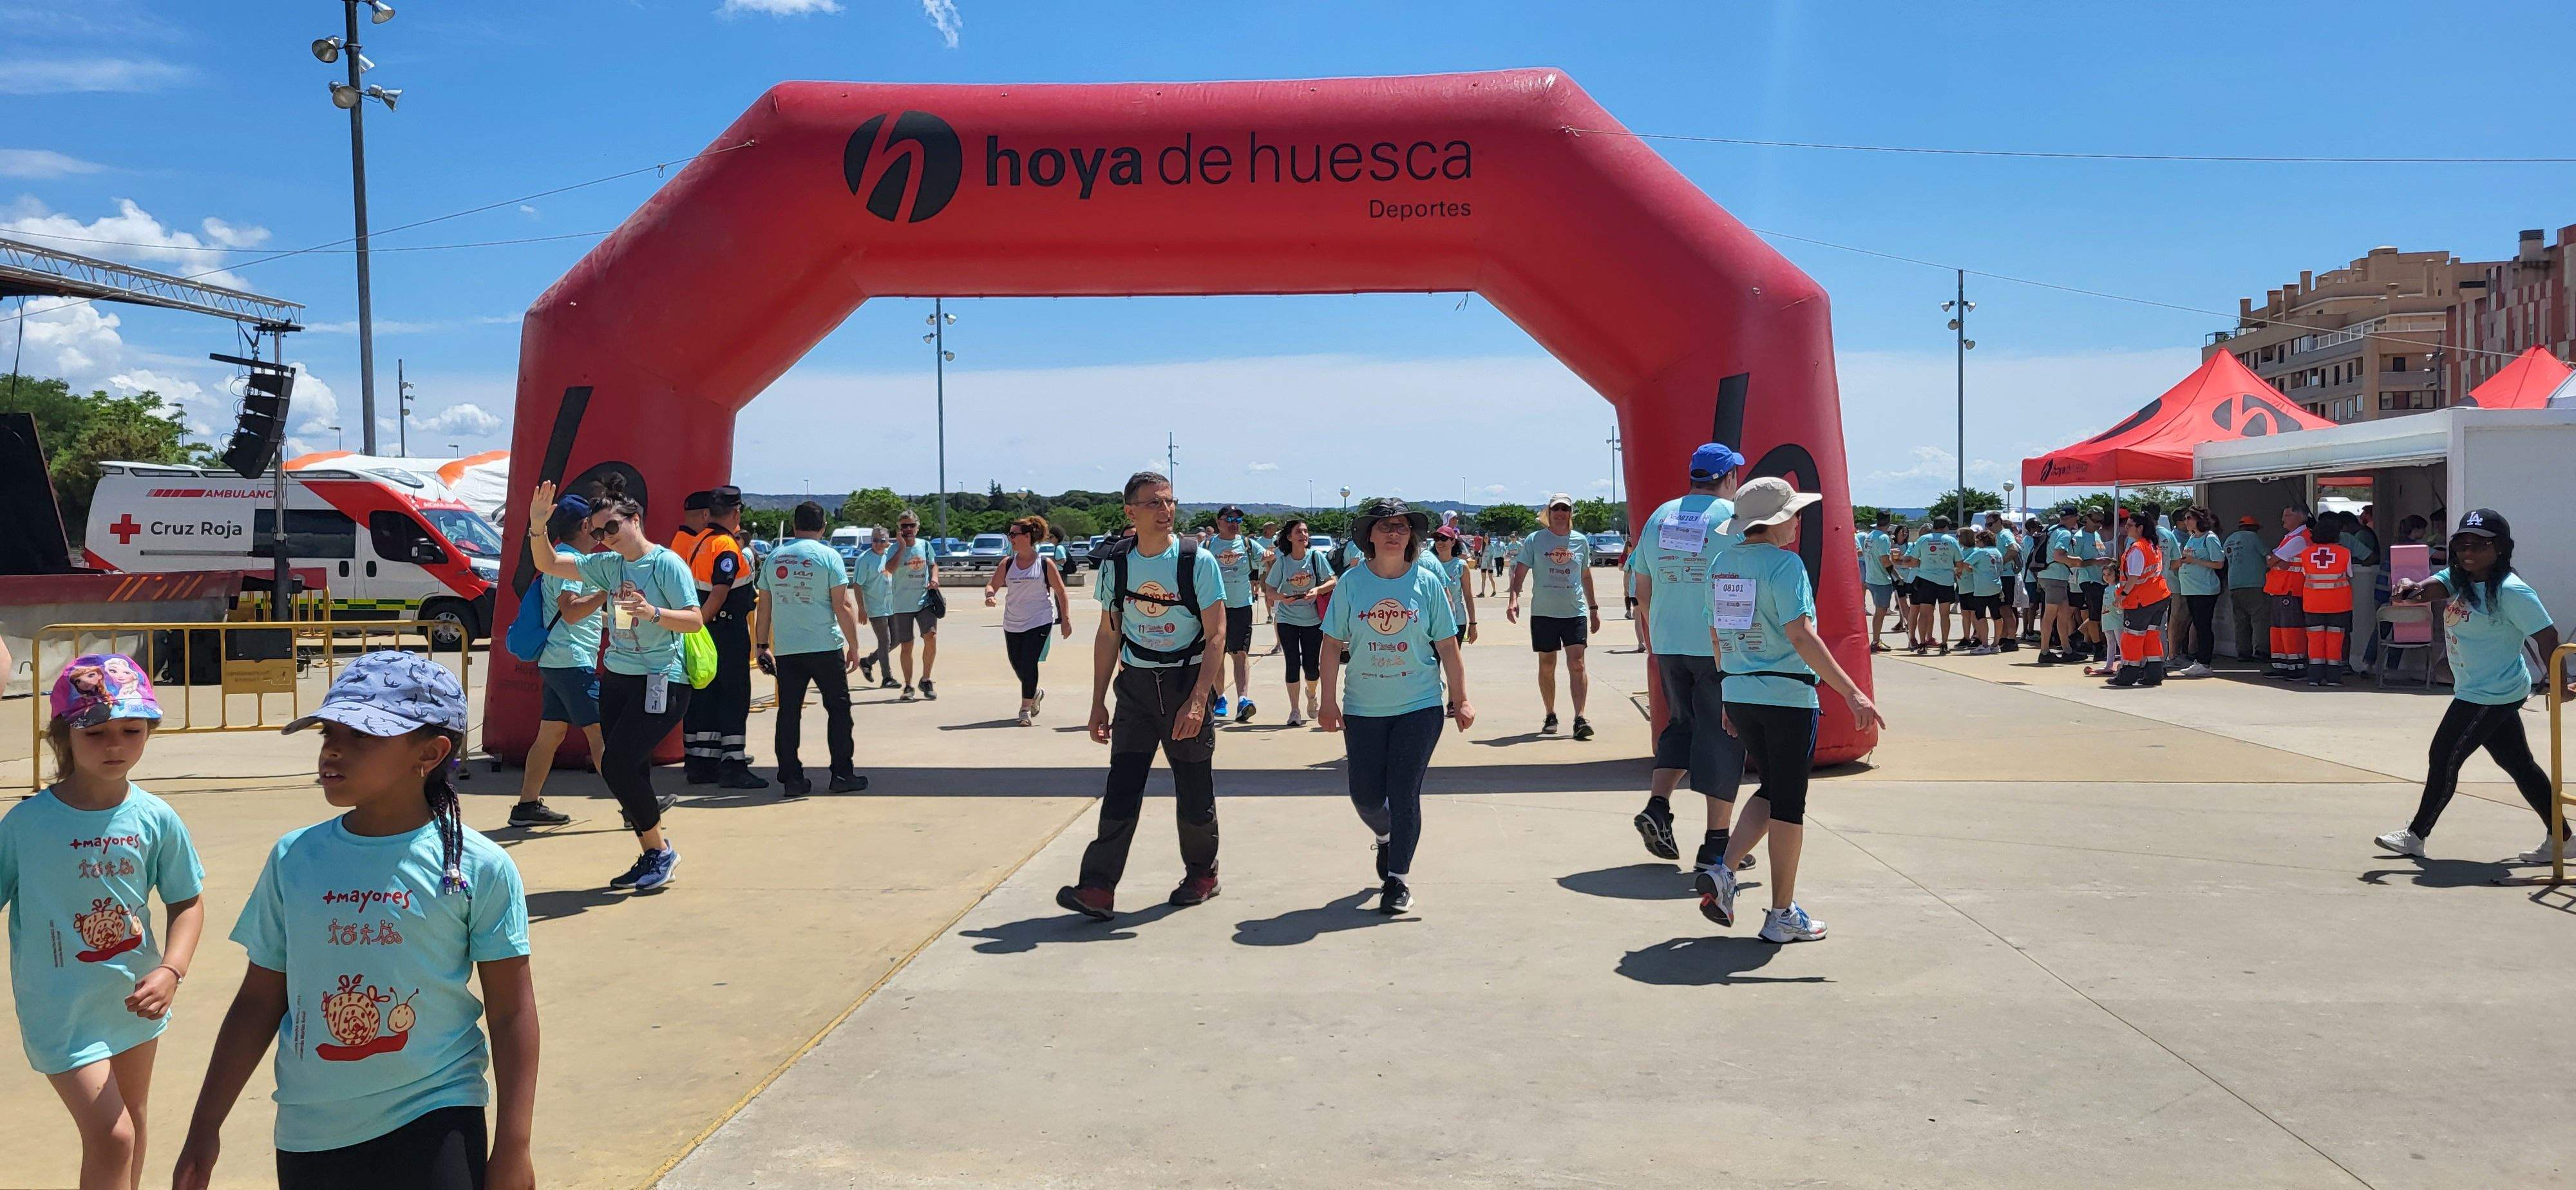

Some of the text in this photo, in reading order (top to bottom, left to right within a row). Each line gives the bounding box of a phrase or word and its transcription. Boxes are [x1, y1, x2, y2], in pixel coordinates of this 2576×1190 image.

[986, 131, 1472, 200] hoya de huesca
[1368, 200, 1472, 220] Deportes
[205, 489, 284, 498] AMBULANC
[2467, 511, 2483, 526] LA
[150, 520, 242, 539] Cruz Roja
[1723, 583, 1744, 592] 08101
[1357, 609, 1419, 626] +mayores
[1138, 624, 1145, 634] 11
[1367, 641, 1376, 651] 11
[69, 834, 140, 855] +mayores
[323, 890, 413, 913] +mayores
